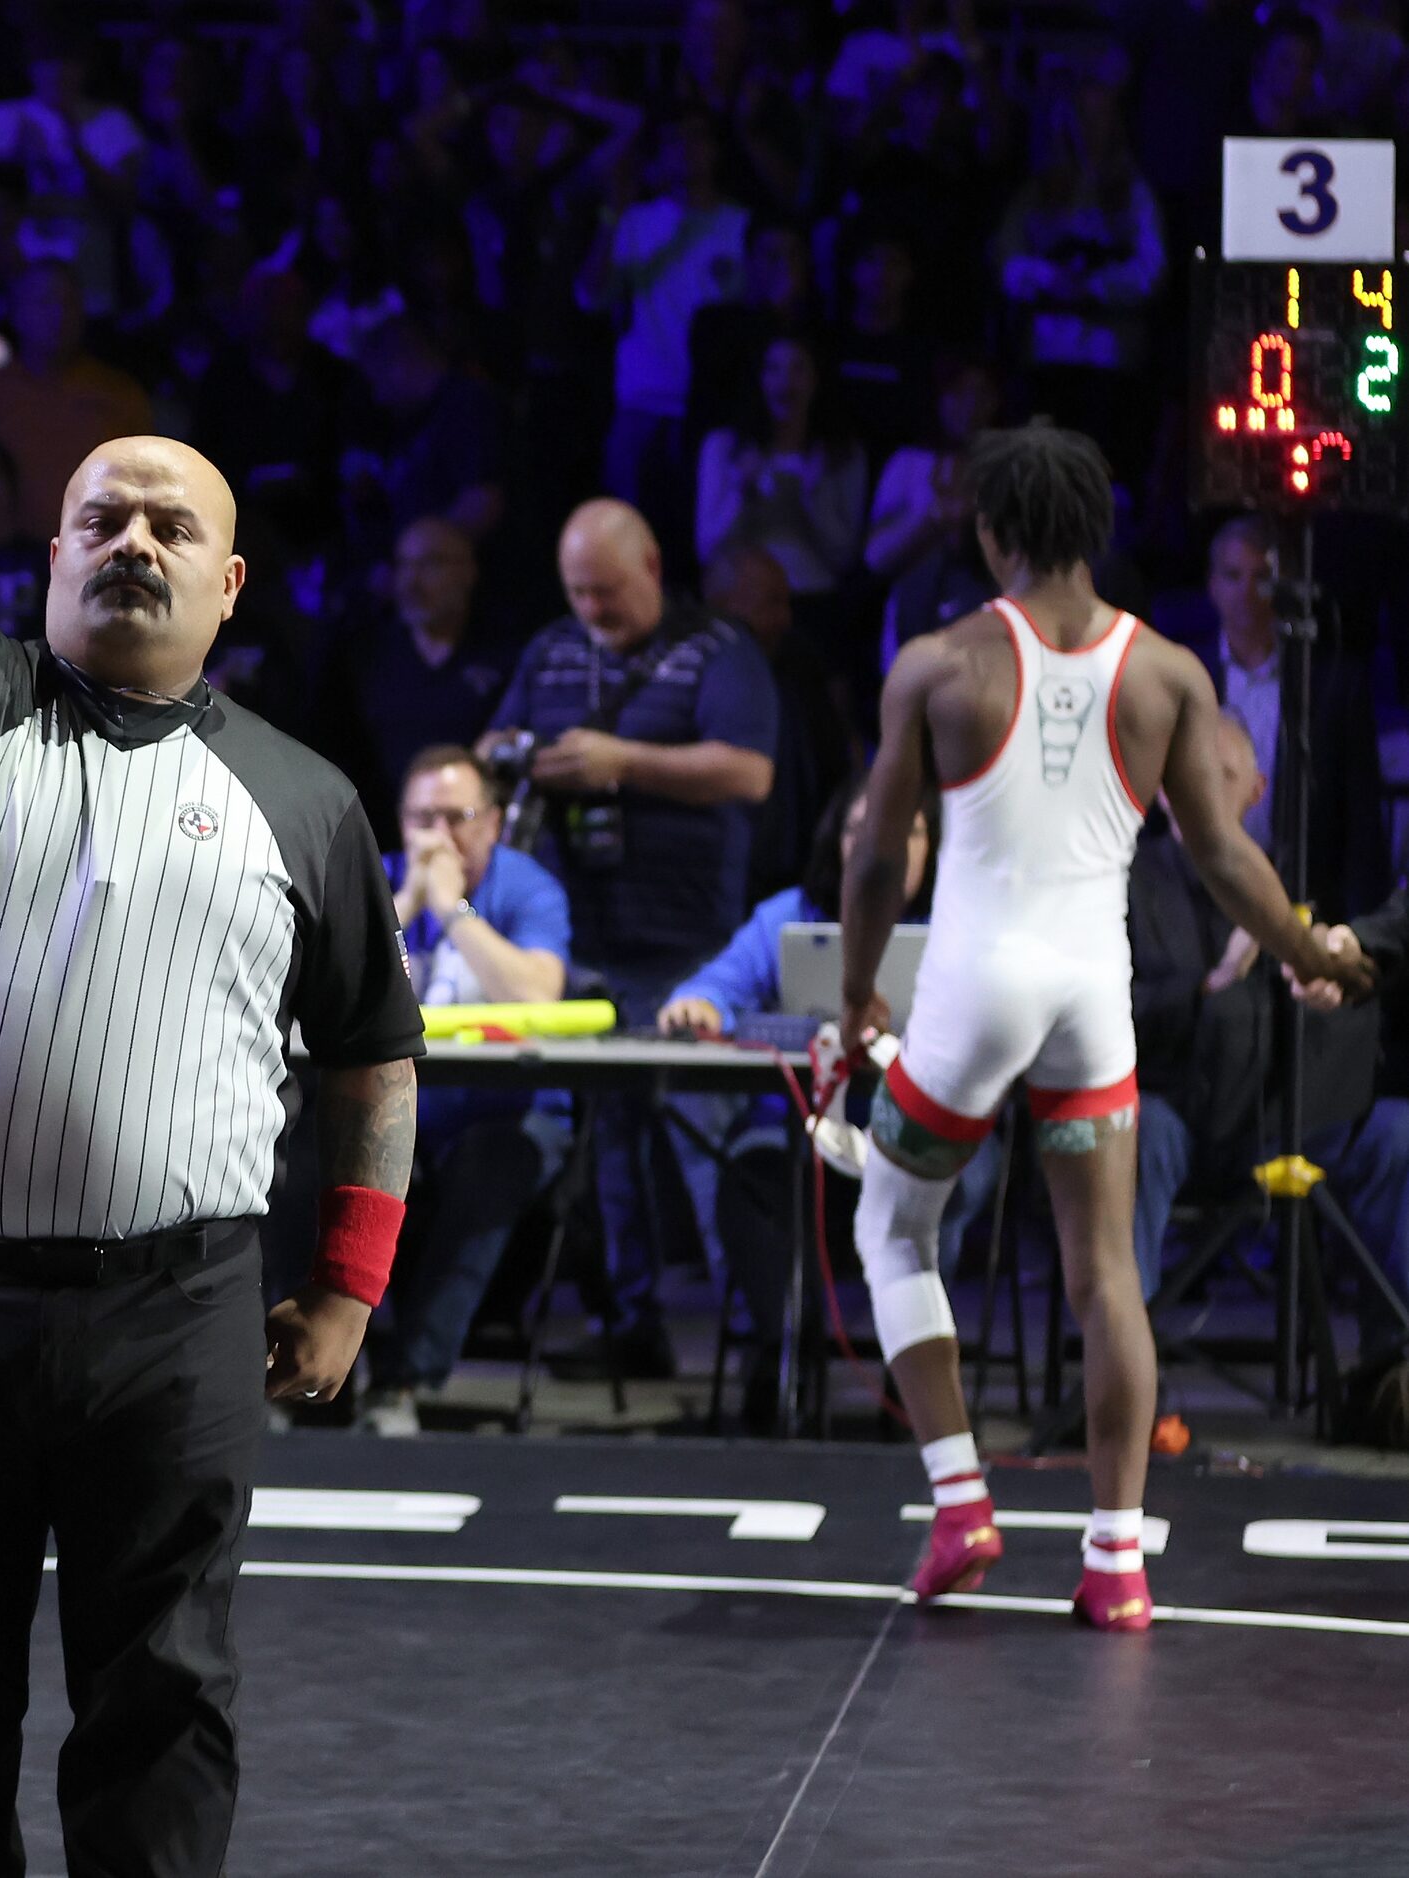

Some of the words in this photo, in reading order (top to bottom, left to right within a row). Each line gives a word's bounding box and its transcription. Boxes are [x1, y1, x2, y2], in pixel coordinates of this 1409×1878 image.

[1277, 149, 1339, 237] 3
[1251, 334, 1291, 408] 0
[1358, 335, 1399, 411] 2
